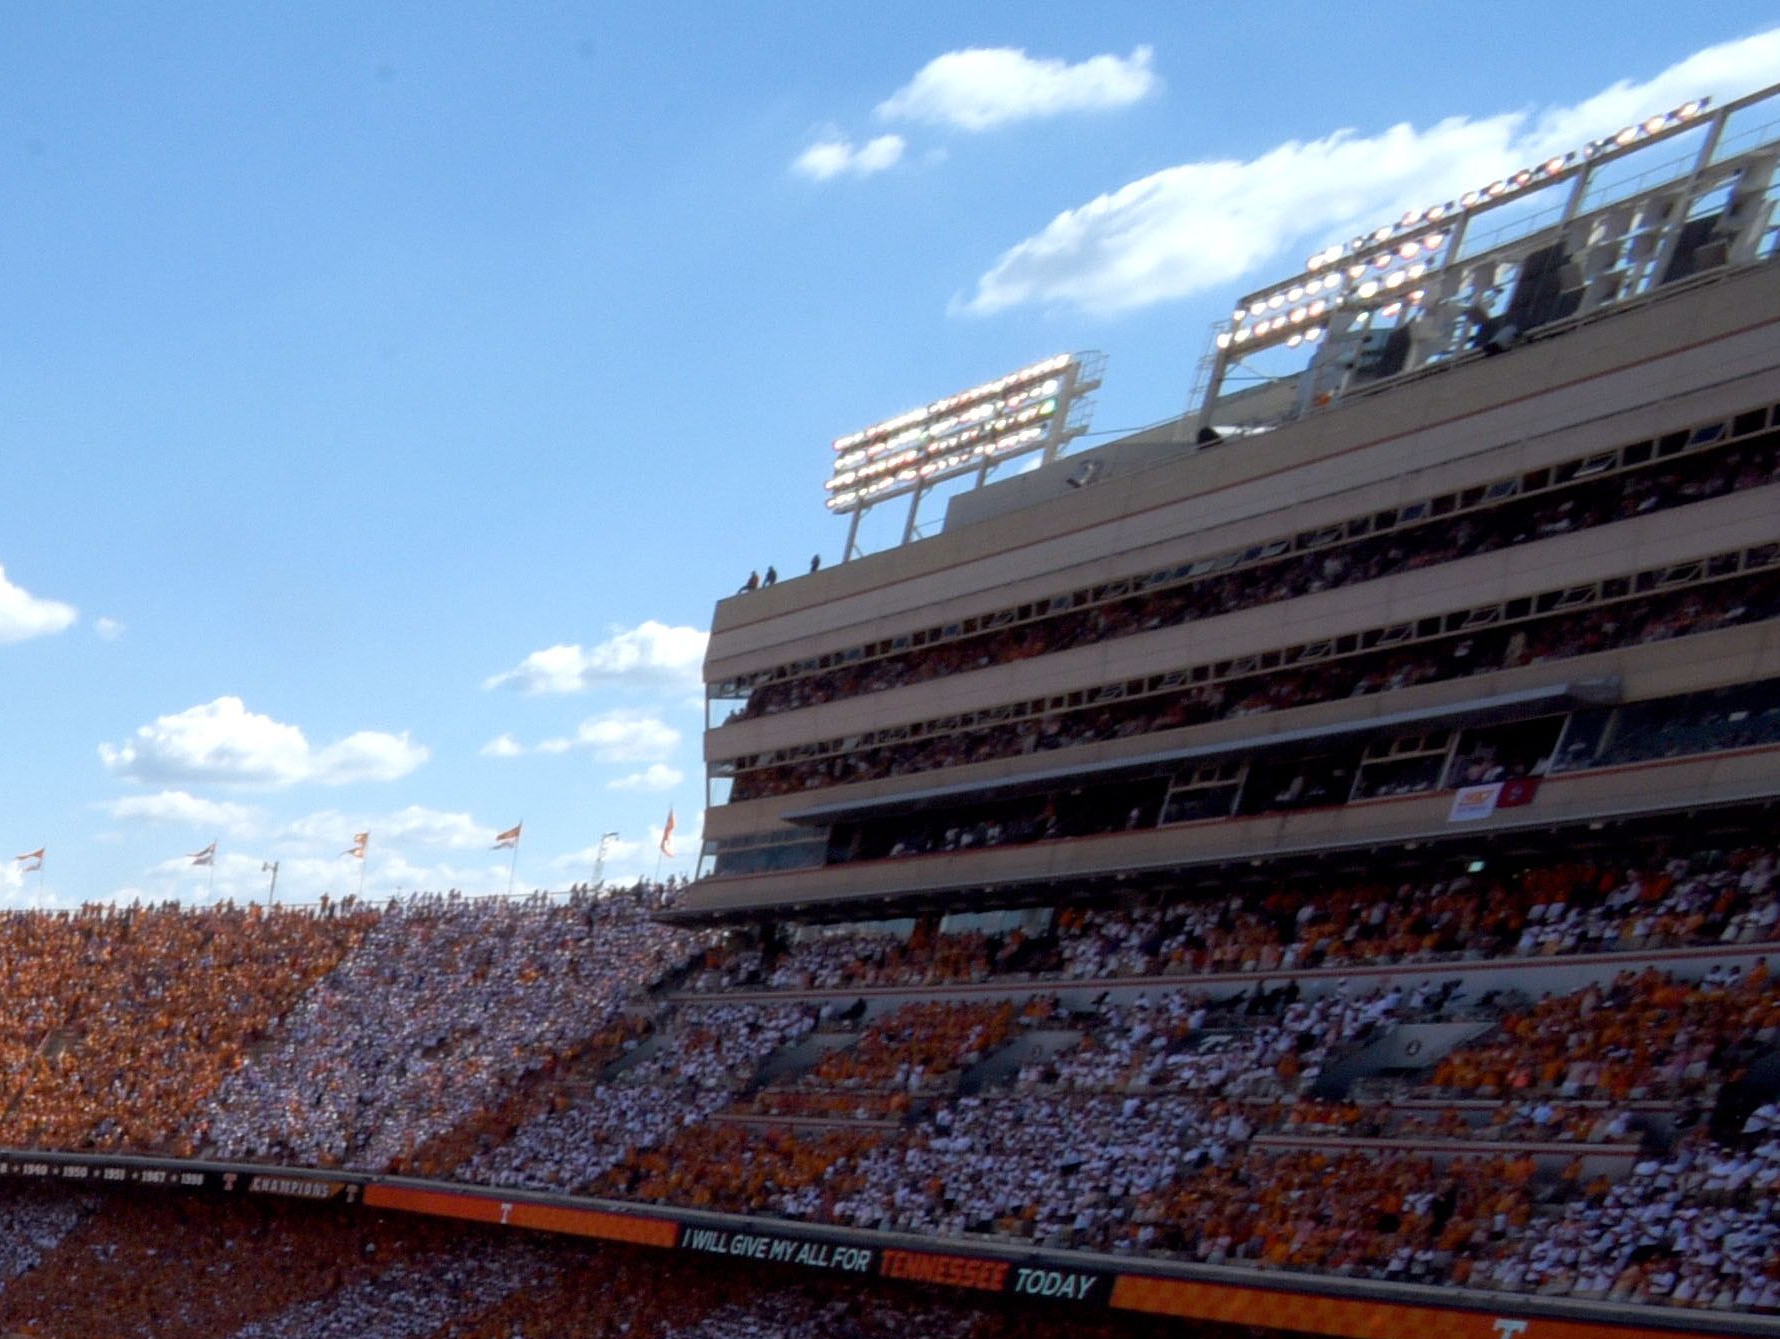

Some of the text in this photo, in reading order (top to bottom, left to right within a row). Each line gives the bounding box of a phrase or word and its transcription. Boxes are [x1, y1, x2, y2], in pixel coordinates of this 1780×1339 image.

[248, 1175, 329, 1198] CHAMPIONS
[682, 1228, 1096, 1300] I WILL GIVE MY ALL FOR TENNESSEE TODAY
